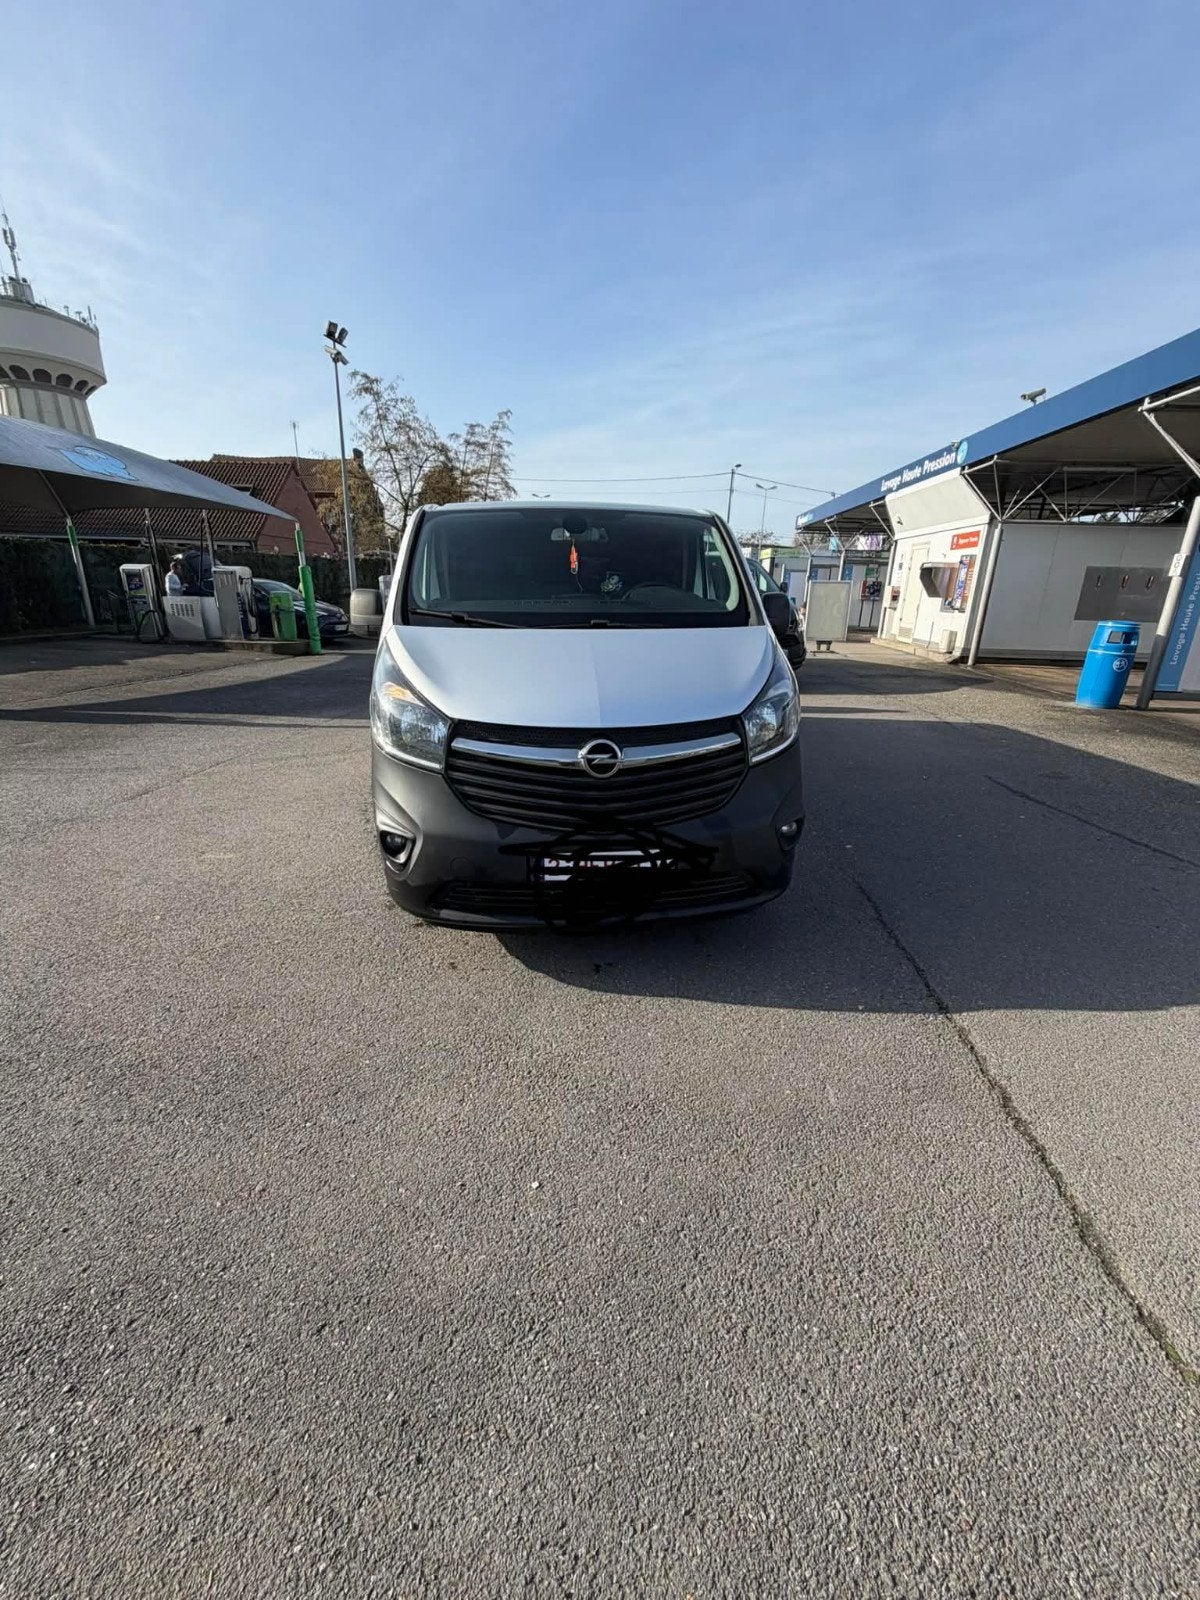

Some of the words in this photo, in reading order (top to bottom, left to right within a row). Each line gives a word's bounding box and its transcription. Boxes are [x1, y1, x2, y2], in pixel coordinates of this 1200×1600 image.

[881, 475, 901, 491] Lavage
[902, 465, 922, 483] Haute
[922, 451, 956, 475] Pression
[1169, 633, 1186, 665] Lavage
[1180, 603, 1195, 630] Haute
